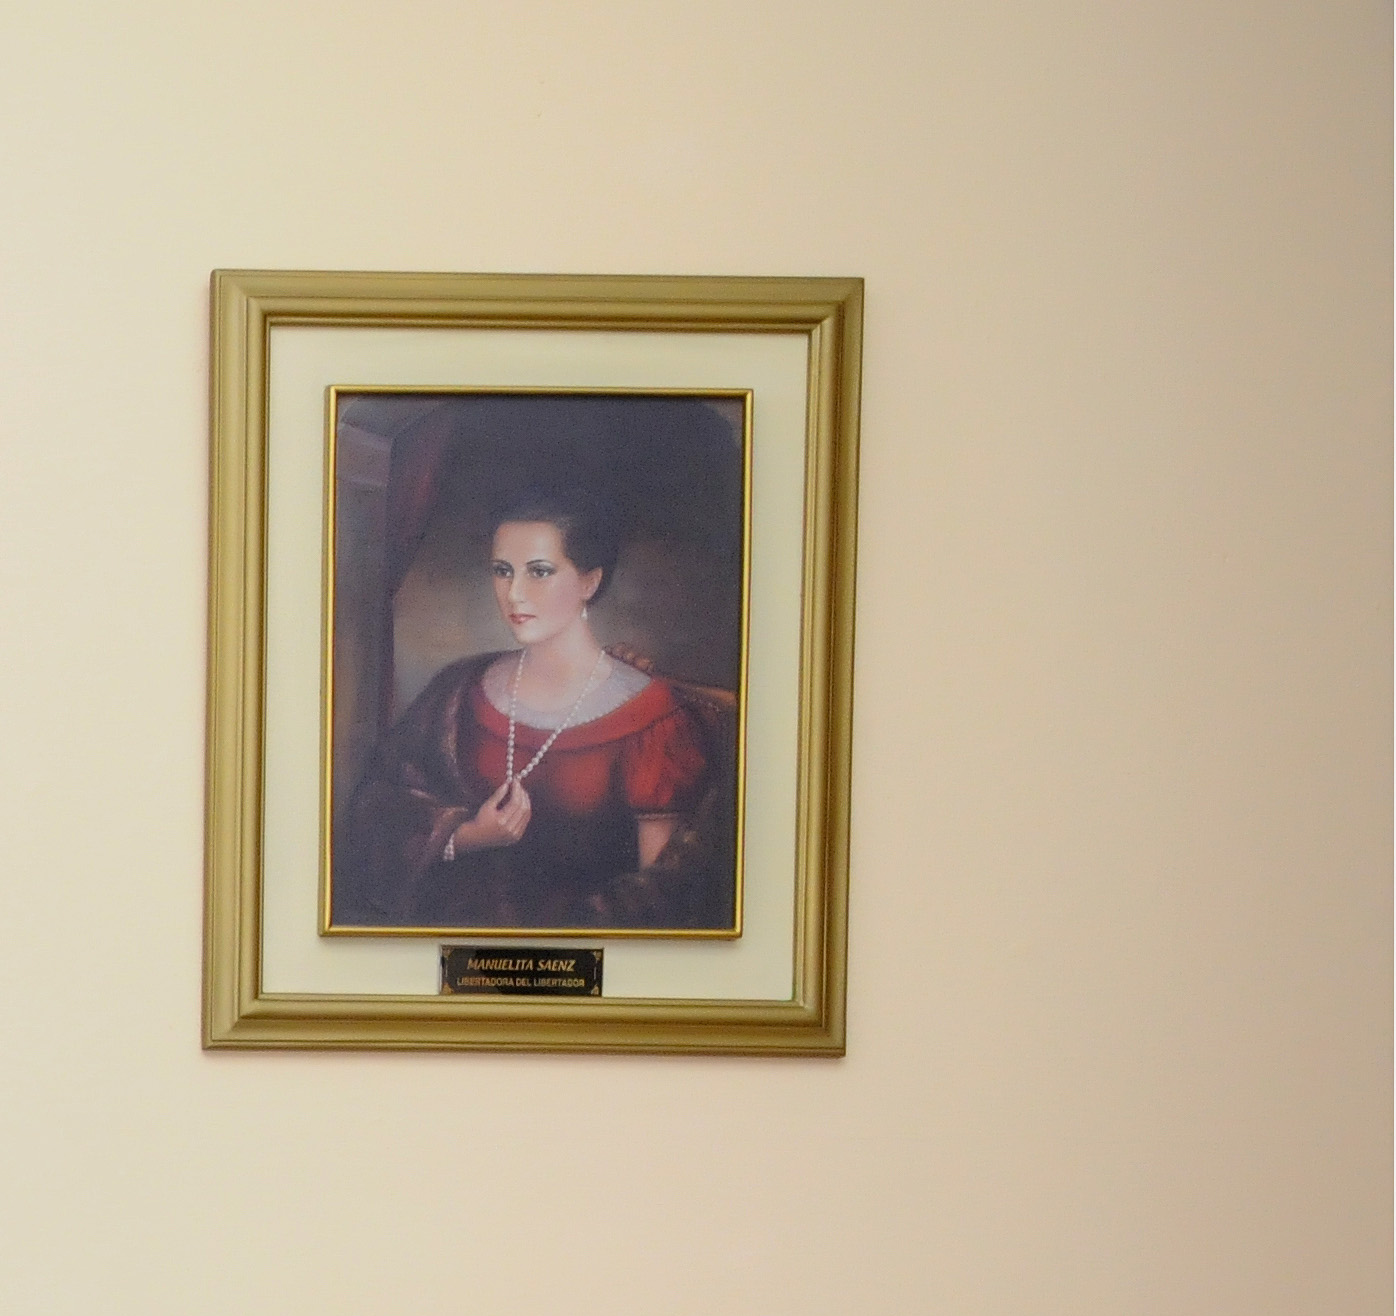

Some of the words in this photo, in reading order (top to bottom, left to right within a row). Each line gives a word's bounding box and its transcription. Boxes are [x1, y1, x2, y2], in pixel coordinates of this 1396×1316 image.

[466, 958, 533, 971] MANUELITA
[537, 958, 576, 972] SAENZ
[457, 976, 514, 987] LIBERTADORA
[516, 977, 531, 987] DEL
[533, 977, 585, 987] LIBERTADOR
